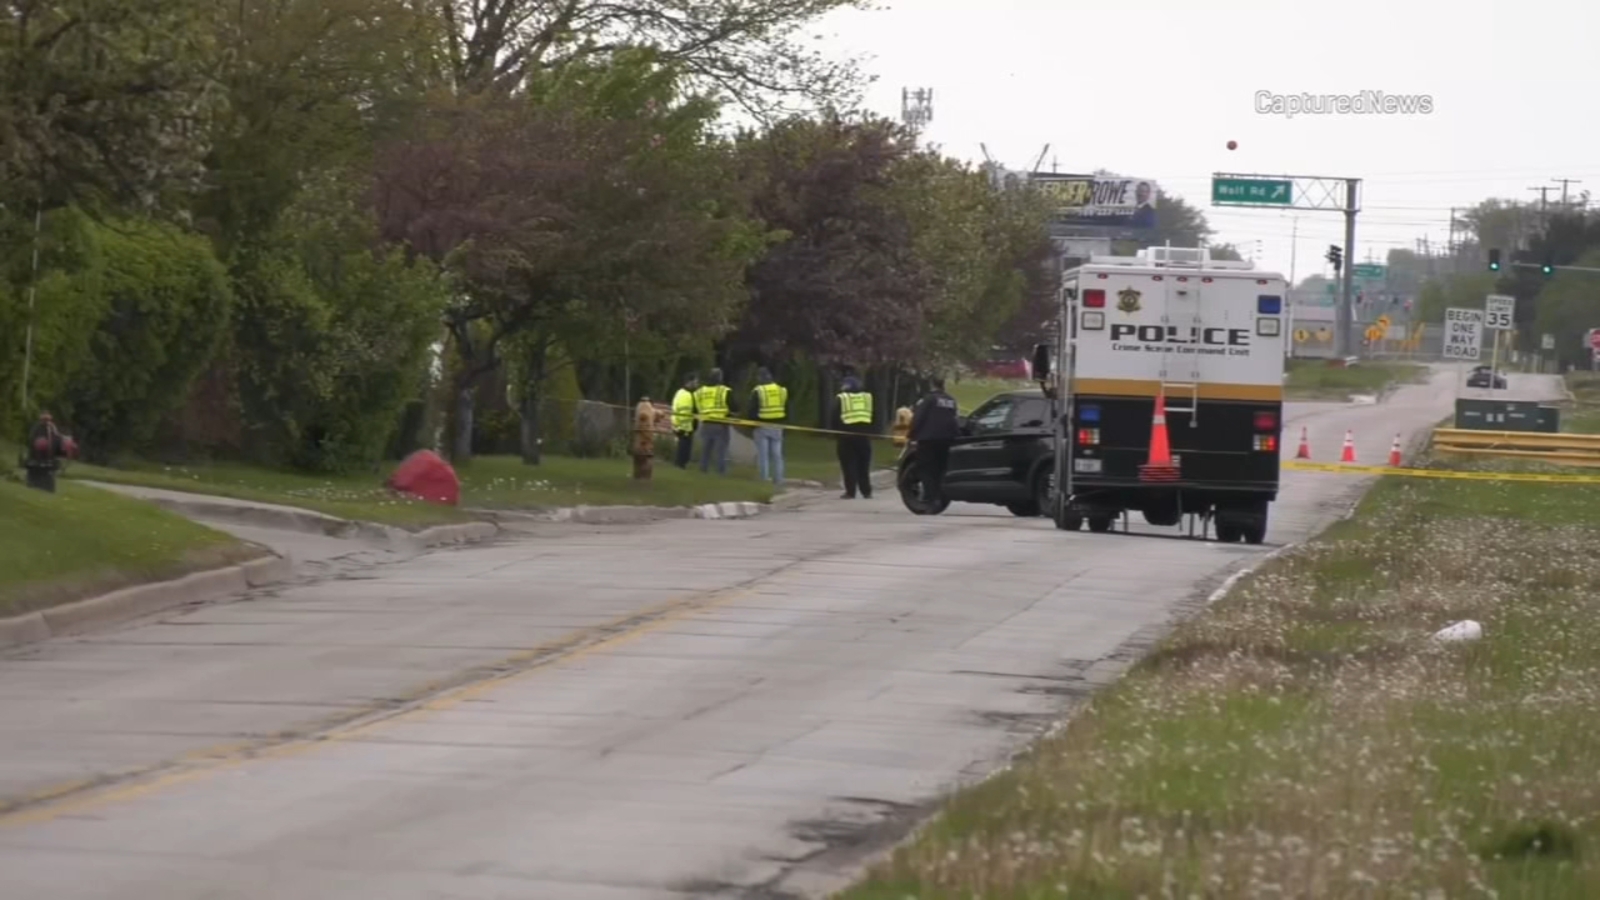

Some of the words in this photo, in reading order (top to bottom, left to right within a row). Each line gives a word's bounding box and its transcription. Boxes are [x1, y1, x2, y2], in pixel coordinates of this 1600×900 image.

[1250, 185, 1266, 197] Rd
[1448, 310, 1481, 321] BEGIN
[1487, 312, 1510, 327] 35
[1453, 321, 1475, 334] ONE
[1110, 323, 1250, 346] POLICE
[1450, 334, 1475, 345] WAY
[1112, 343, 1141, 352] Crime
[1144, 344, 1174, 353] Scene
[1176, 345, 1226, 356] Command
[1228, 347, 1250, 357] Unit
[1445, 344, 1478, 357] ROAD
